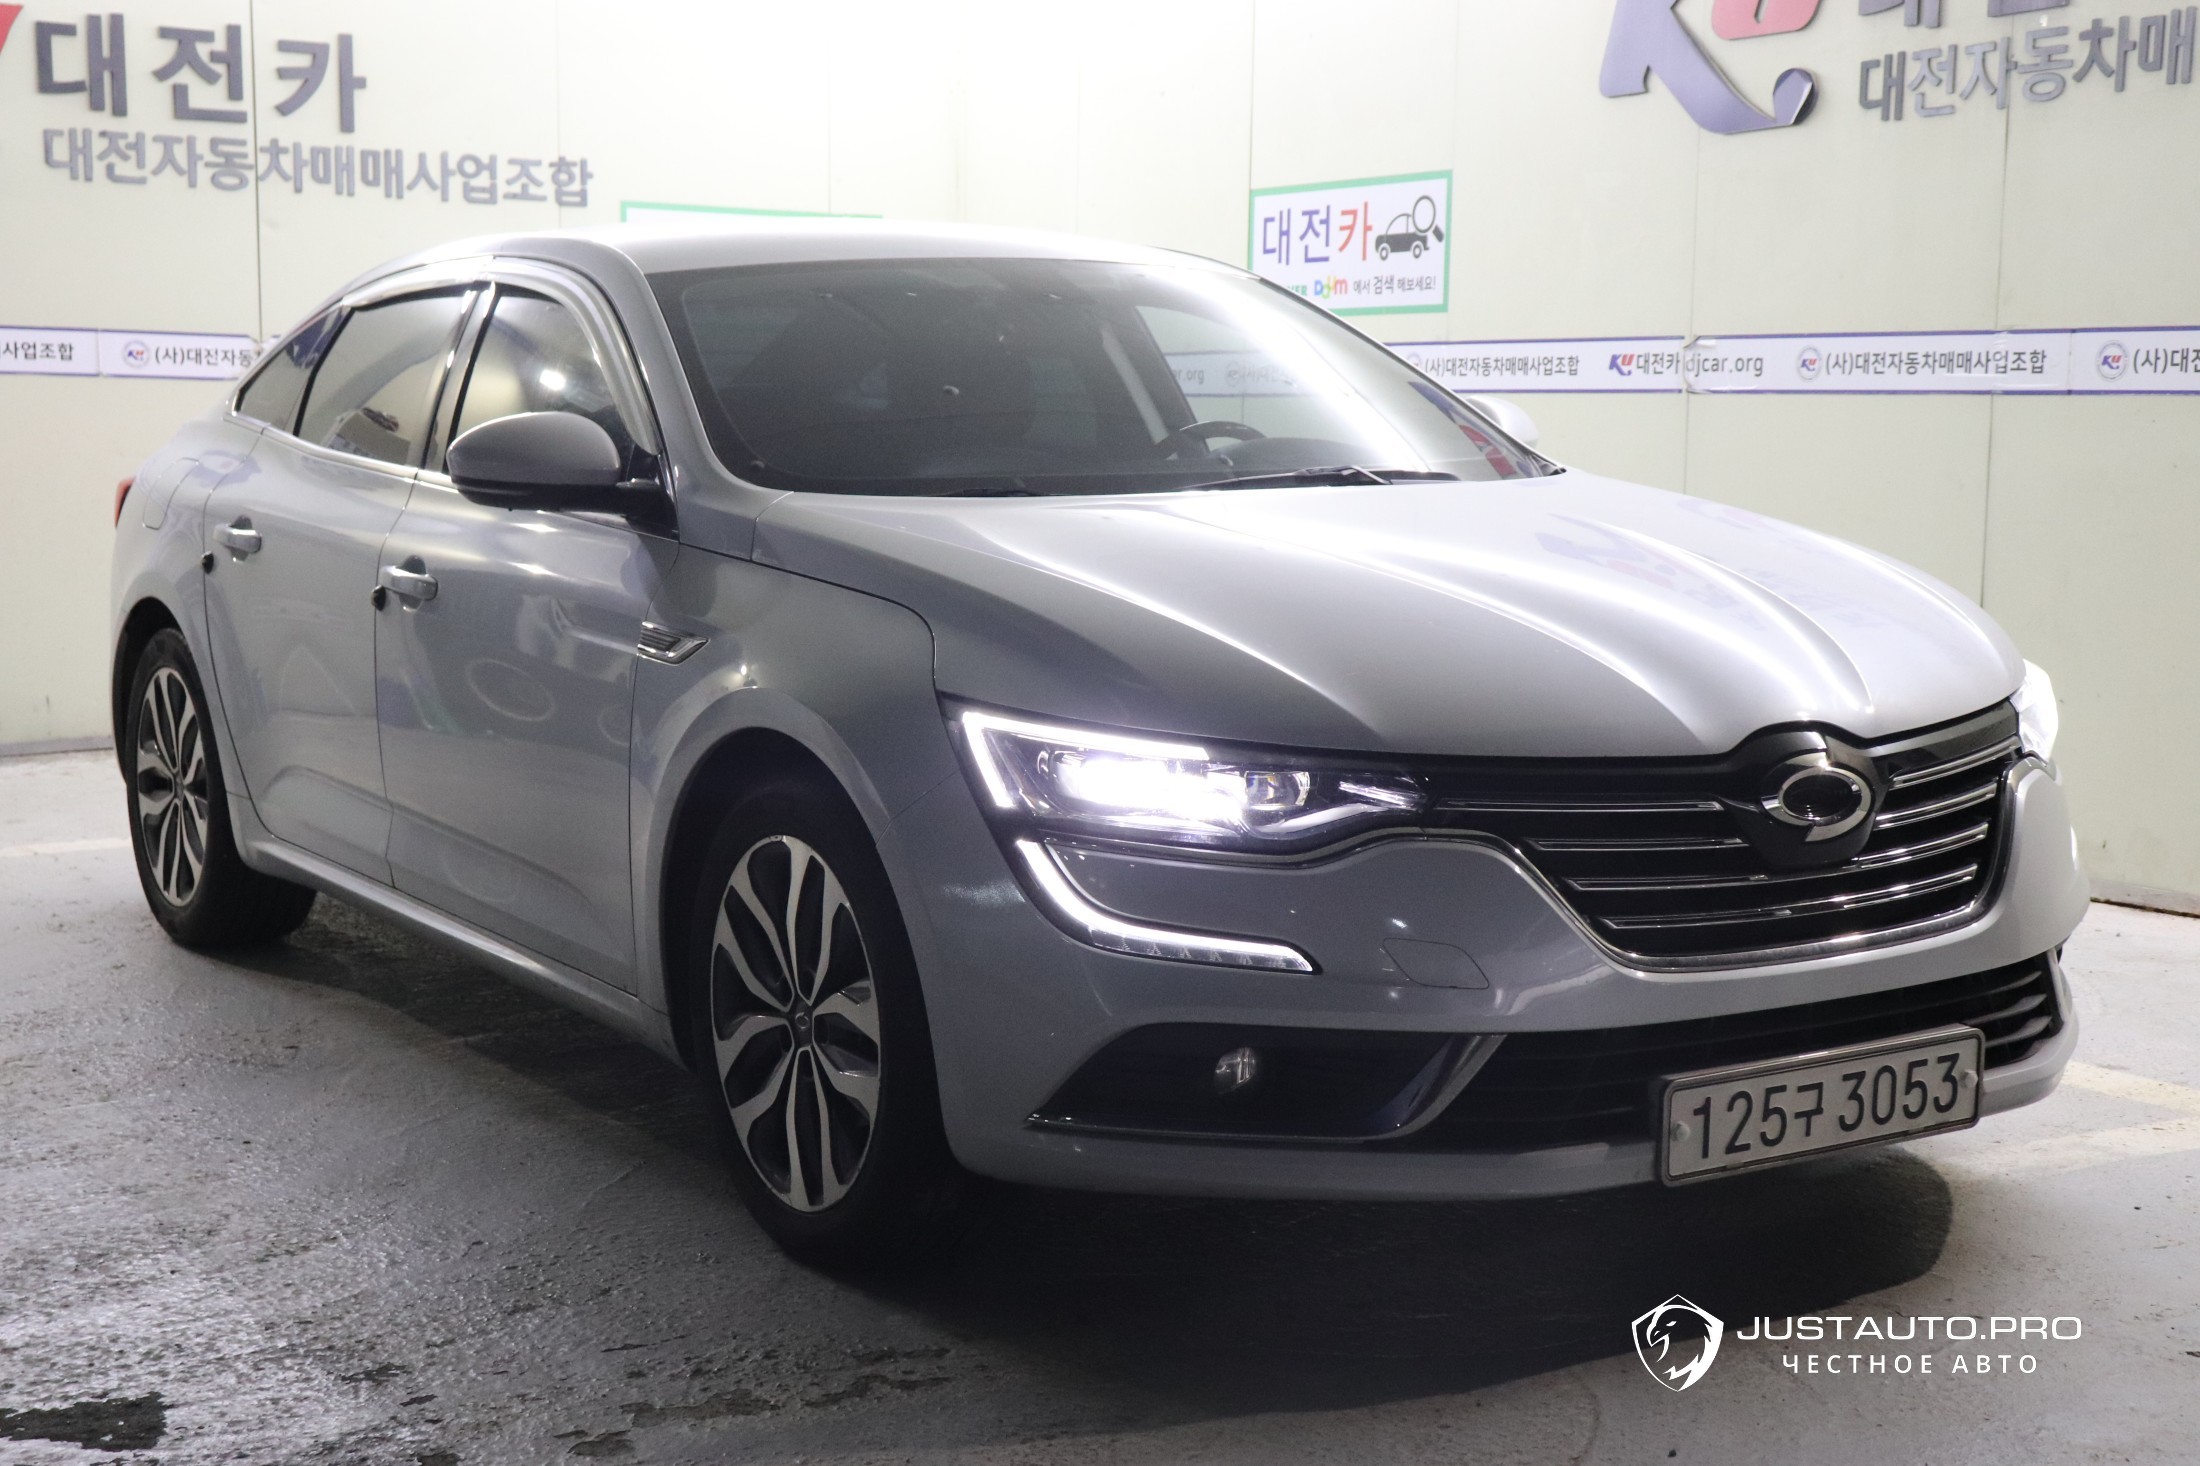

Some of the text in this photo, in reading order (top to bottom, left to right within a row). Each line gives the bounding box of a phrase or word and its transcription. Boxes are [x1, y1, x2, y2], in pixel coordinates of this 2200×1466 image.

[35, 13, 367, 132] 대전카
[43, 128, 593, 207] 대전자동차매매사업조합
[1263, 201, 1373, 265] 대전카
[1353, 279, 1371, 294] 에서
[1373, 275, 1394, 294] 검색
[1397, 275, 1437, 292] 해보세요!
[0, 341, 74, 361] 사업조합
[155, 346, 261, 368] (사)대전자동
[1636, 351, 1680, 374] 대전카
[1686, 353, 1764, 377] djcar.org
[1825, 349, 2047, 376] (사)대전자동차매매사업조합
[1425, 355, 1579, 377] (사)대전자동차매매사업조합
[1693, 1053, 1961, 1160] 125구 3053
